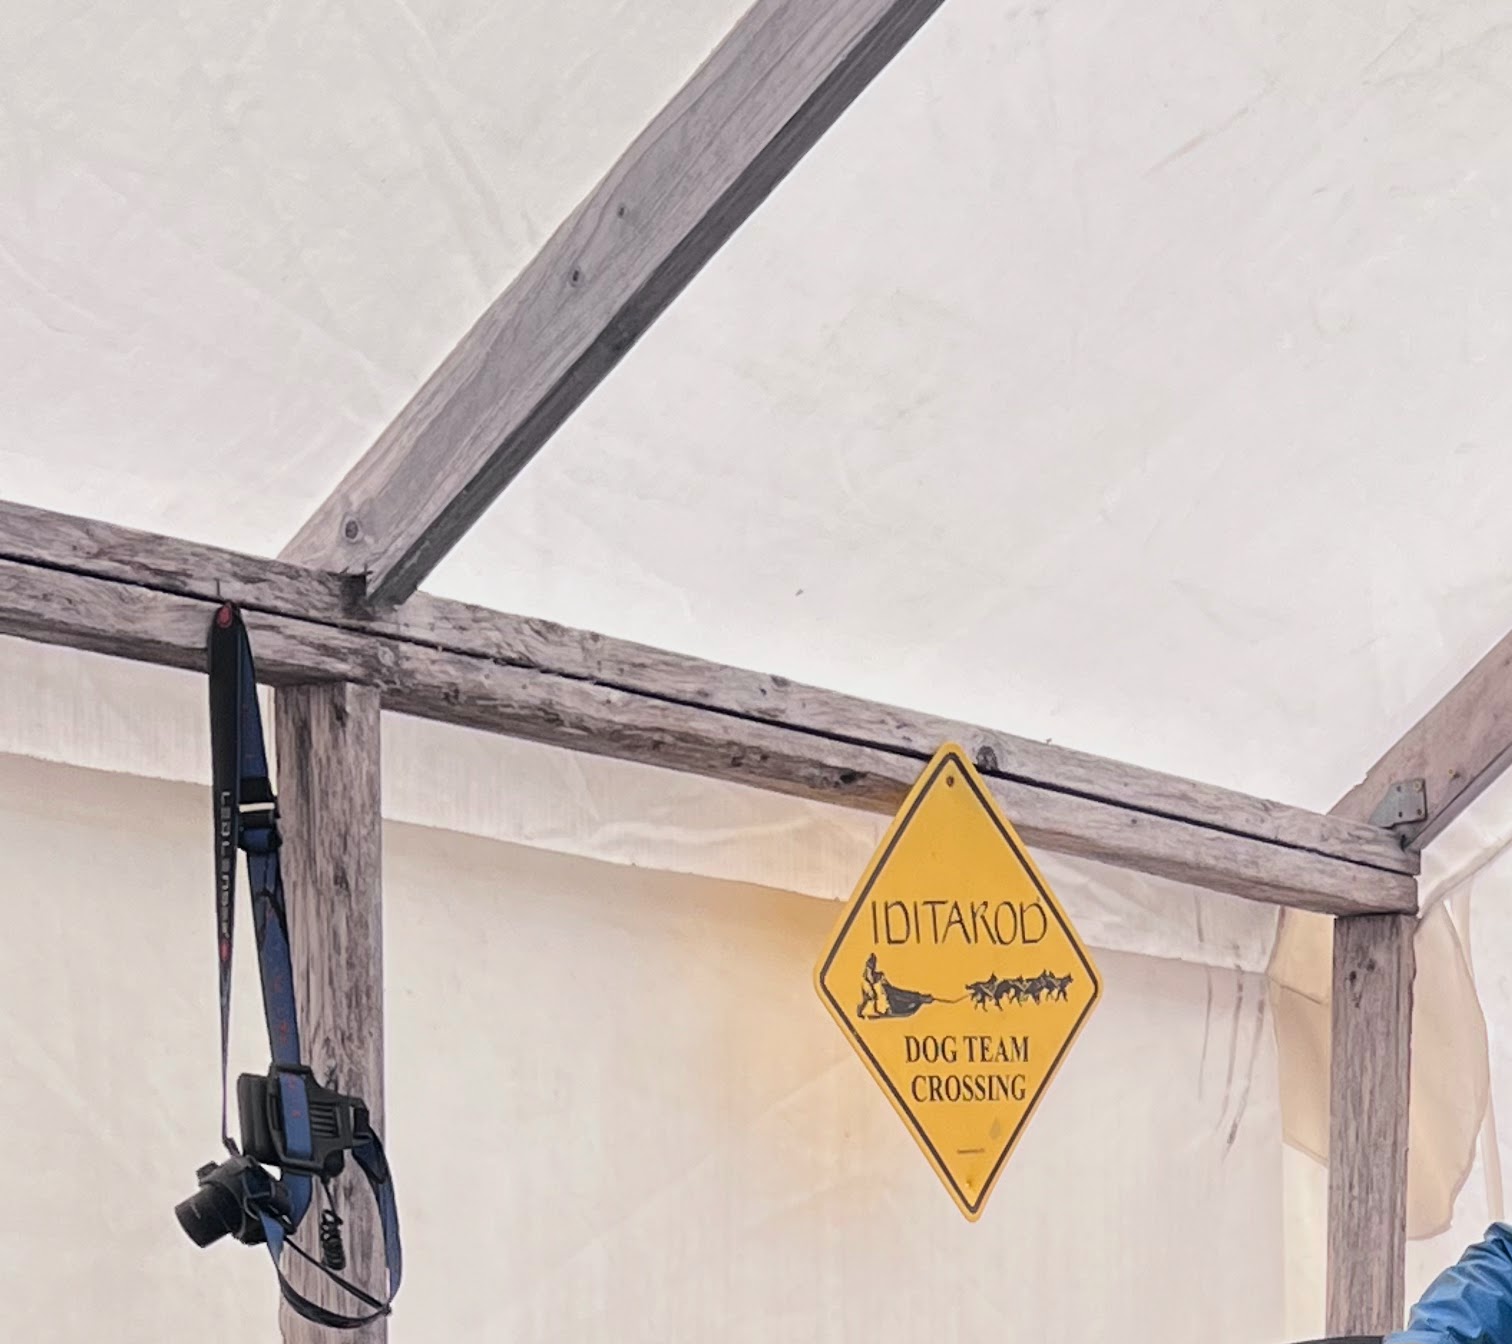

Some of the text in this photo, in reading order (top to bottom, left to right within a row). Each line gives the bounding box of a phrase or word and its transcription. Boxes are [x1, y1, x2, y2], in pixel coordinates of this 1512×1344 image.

[871, 900, 1048, 945] IDITAROD
[904, 1035, 1030, 1063] DOG TEAM
[911, 1074, 1027, 1102] CROSSING
